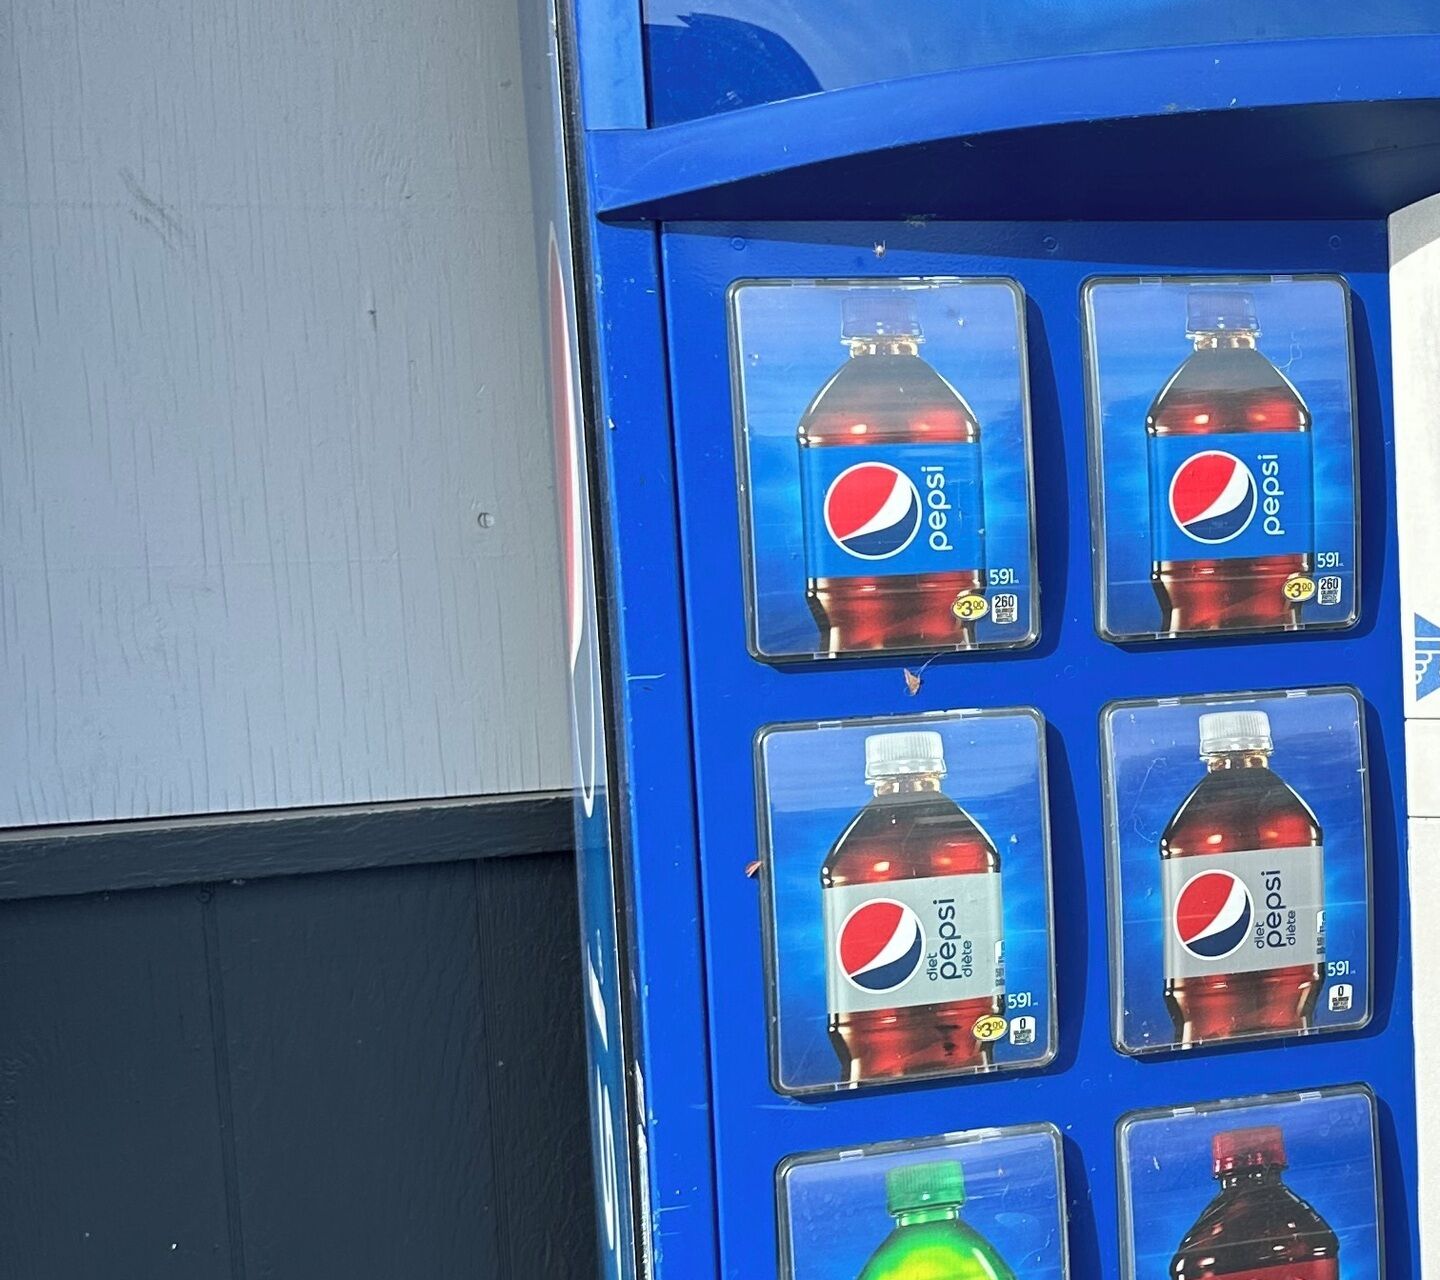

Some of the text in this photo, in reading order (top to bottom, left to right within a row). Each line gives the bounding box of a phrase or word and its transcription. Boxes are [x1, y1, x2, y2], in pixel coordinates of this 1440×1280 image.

[921, 466, 953, 551] pepsi
[1257, 454, 1284, 535] pepsi
[1317, 552, 1340, 568] 591
[989, 568, 1014, 586] 591
[1320, 578, 1339, 590] 260
[994, 595, 1015, 608] 260
[1261, 870, 1287, 948] pepsi
[933, 898, 962, 980] pepsi
[1254, 921, 1265, 949] diet
[1286, 910, 1296, 946] diète
[927, 951, 938, 981] diet
[962, 940, 973, 977] diète
[1328, 960, 1350, 977] 591
[1008, 992, 1032, 1009] 591
